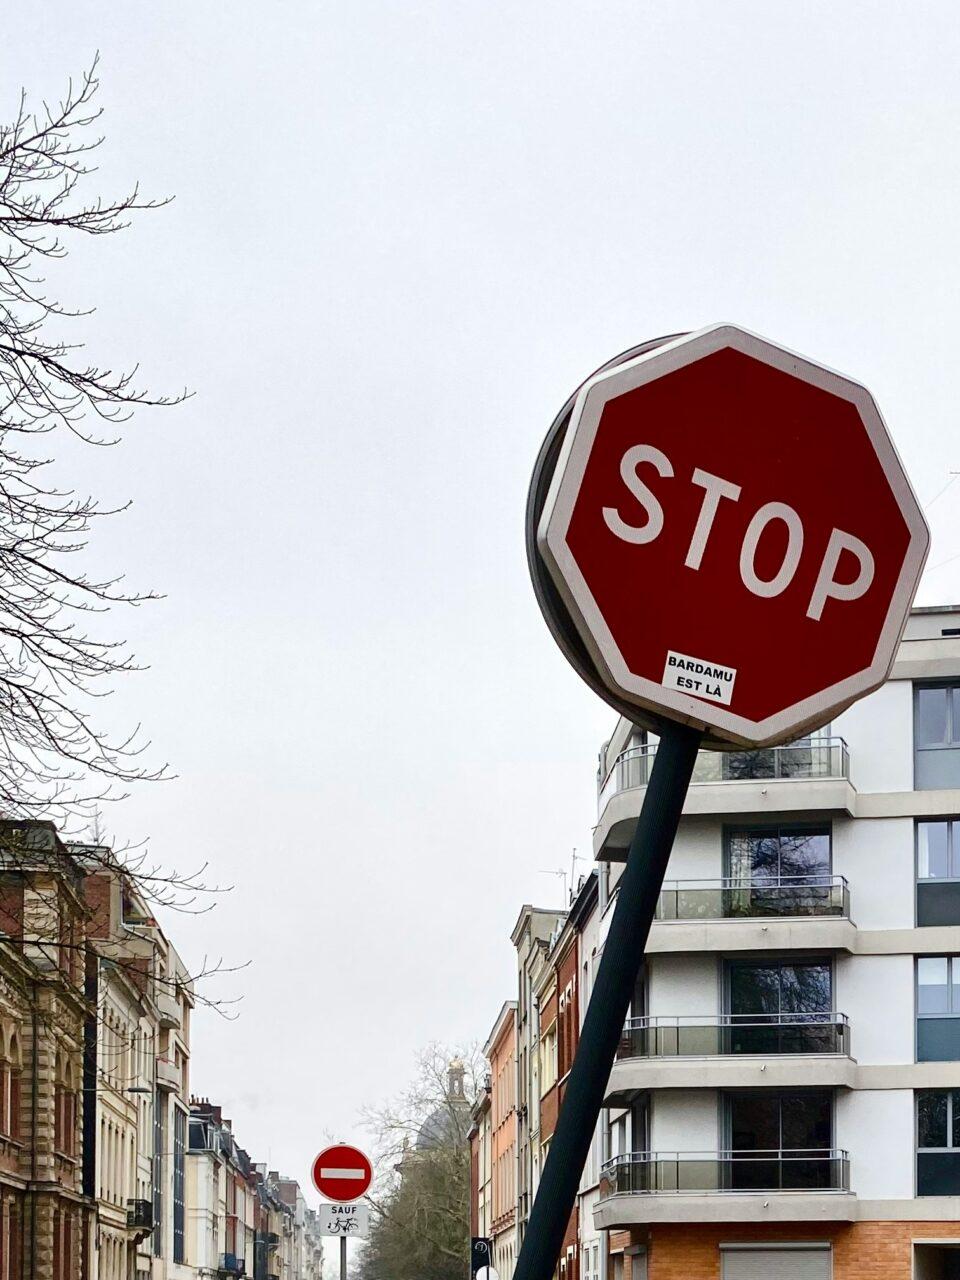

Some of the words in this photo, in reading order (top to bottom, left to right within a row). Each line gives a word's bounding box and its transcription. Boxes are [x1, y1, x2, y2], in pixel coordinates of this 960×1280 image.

[602, 444, 875, 621] STOP
[668, 656, 733, 682] BARDAMU
[677, 676, 702, 691] EST
[705, 684, 722, 698] LÀ
[331, 1206, 357, 1214] SAUF
